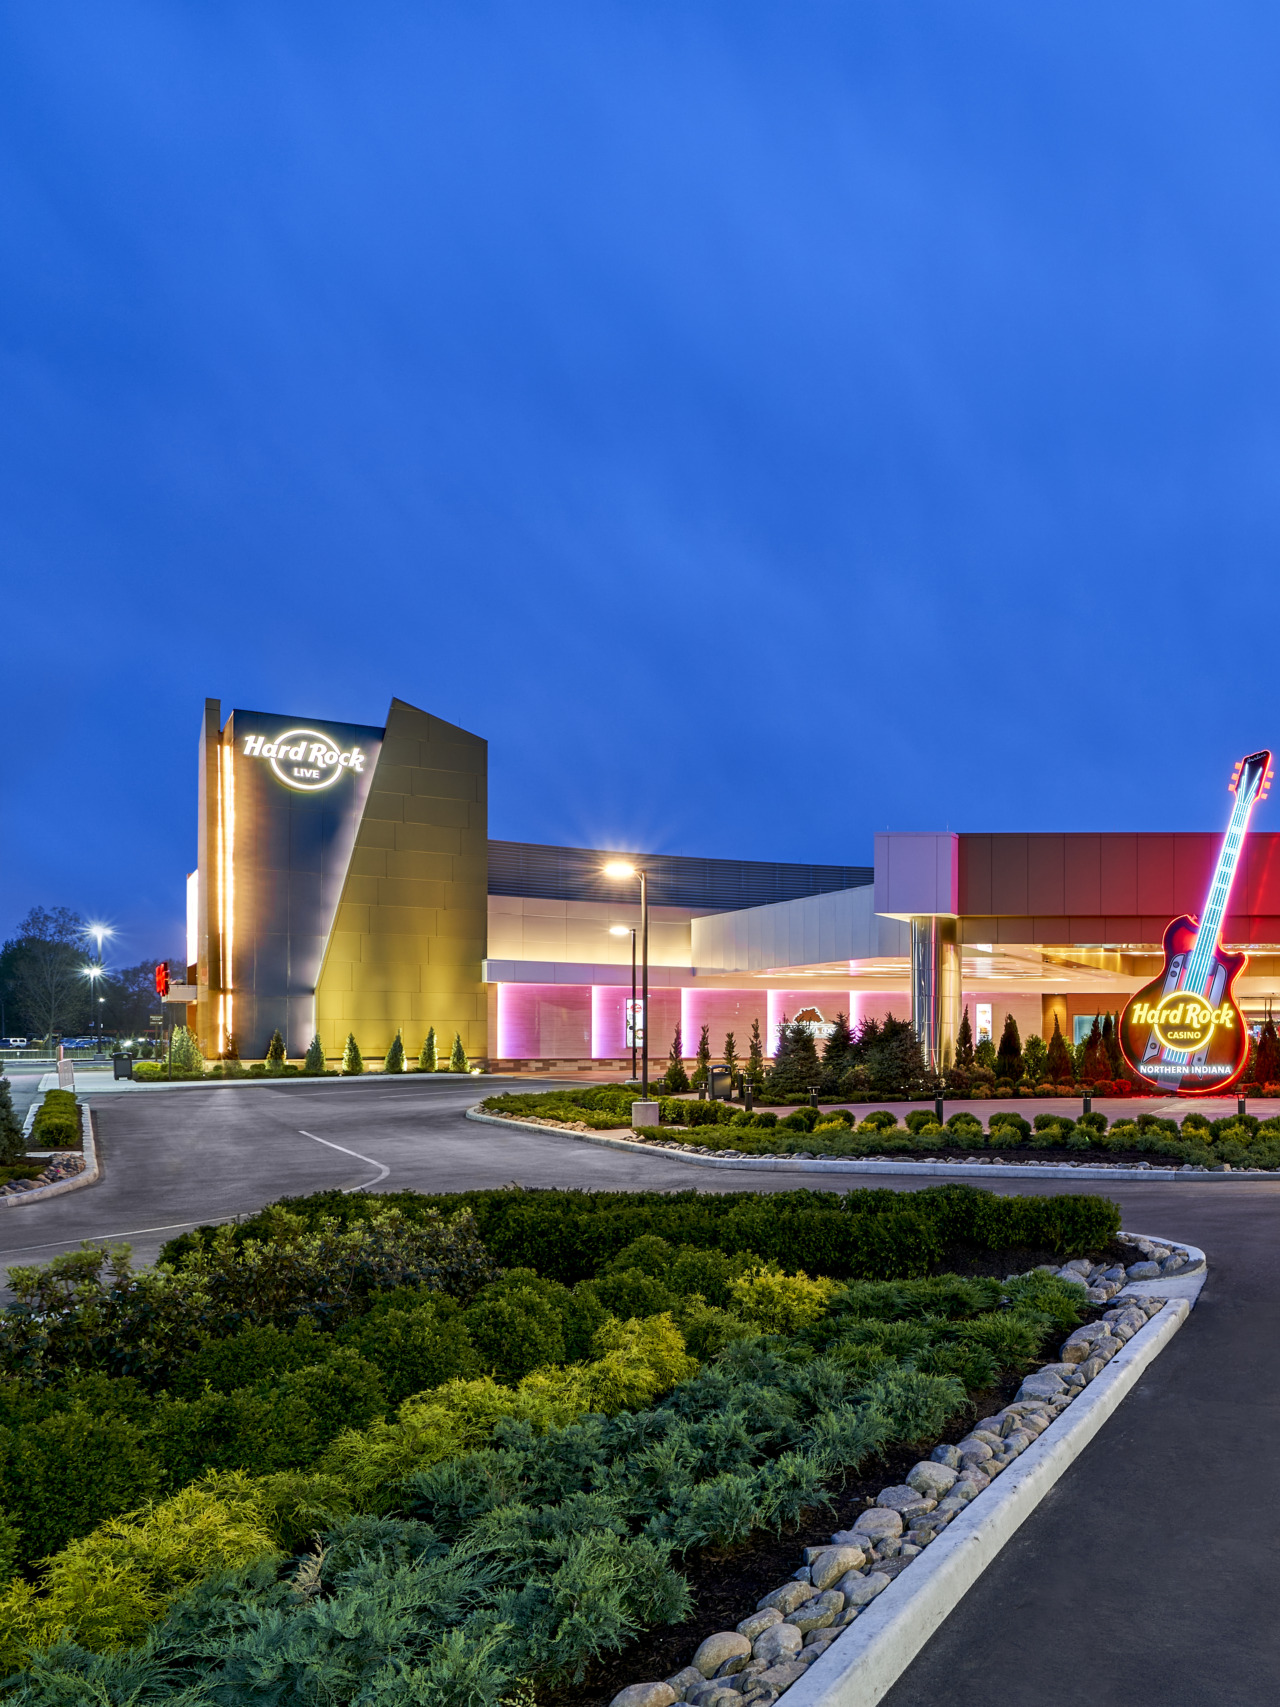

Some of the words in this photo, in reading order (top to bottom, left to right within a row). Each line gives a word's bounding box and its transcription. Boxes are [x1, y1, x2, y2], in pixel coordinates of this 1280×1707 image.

[243, 735, 308, 761] Hard
[308, 743, 365, 772] Rock
[293, 767, 320, 779] LIVE
[1132, 1003, 1184, 1025] Hard
[1184, 1003, 1234, 1029] Rock
[1167, 1031, 1202, 1040] CASINO
[1140, 1065, 1189, 1074] NORTHERN
[1191, 1065, 1232, 1074] INDIANA
